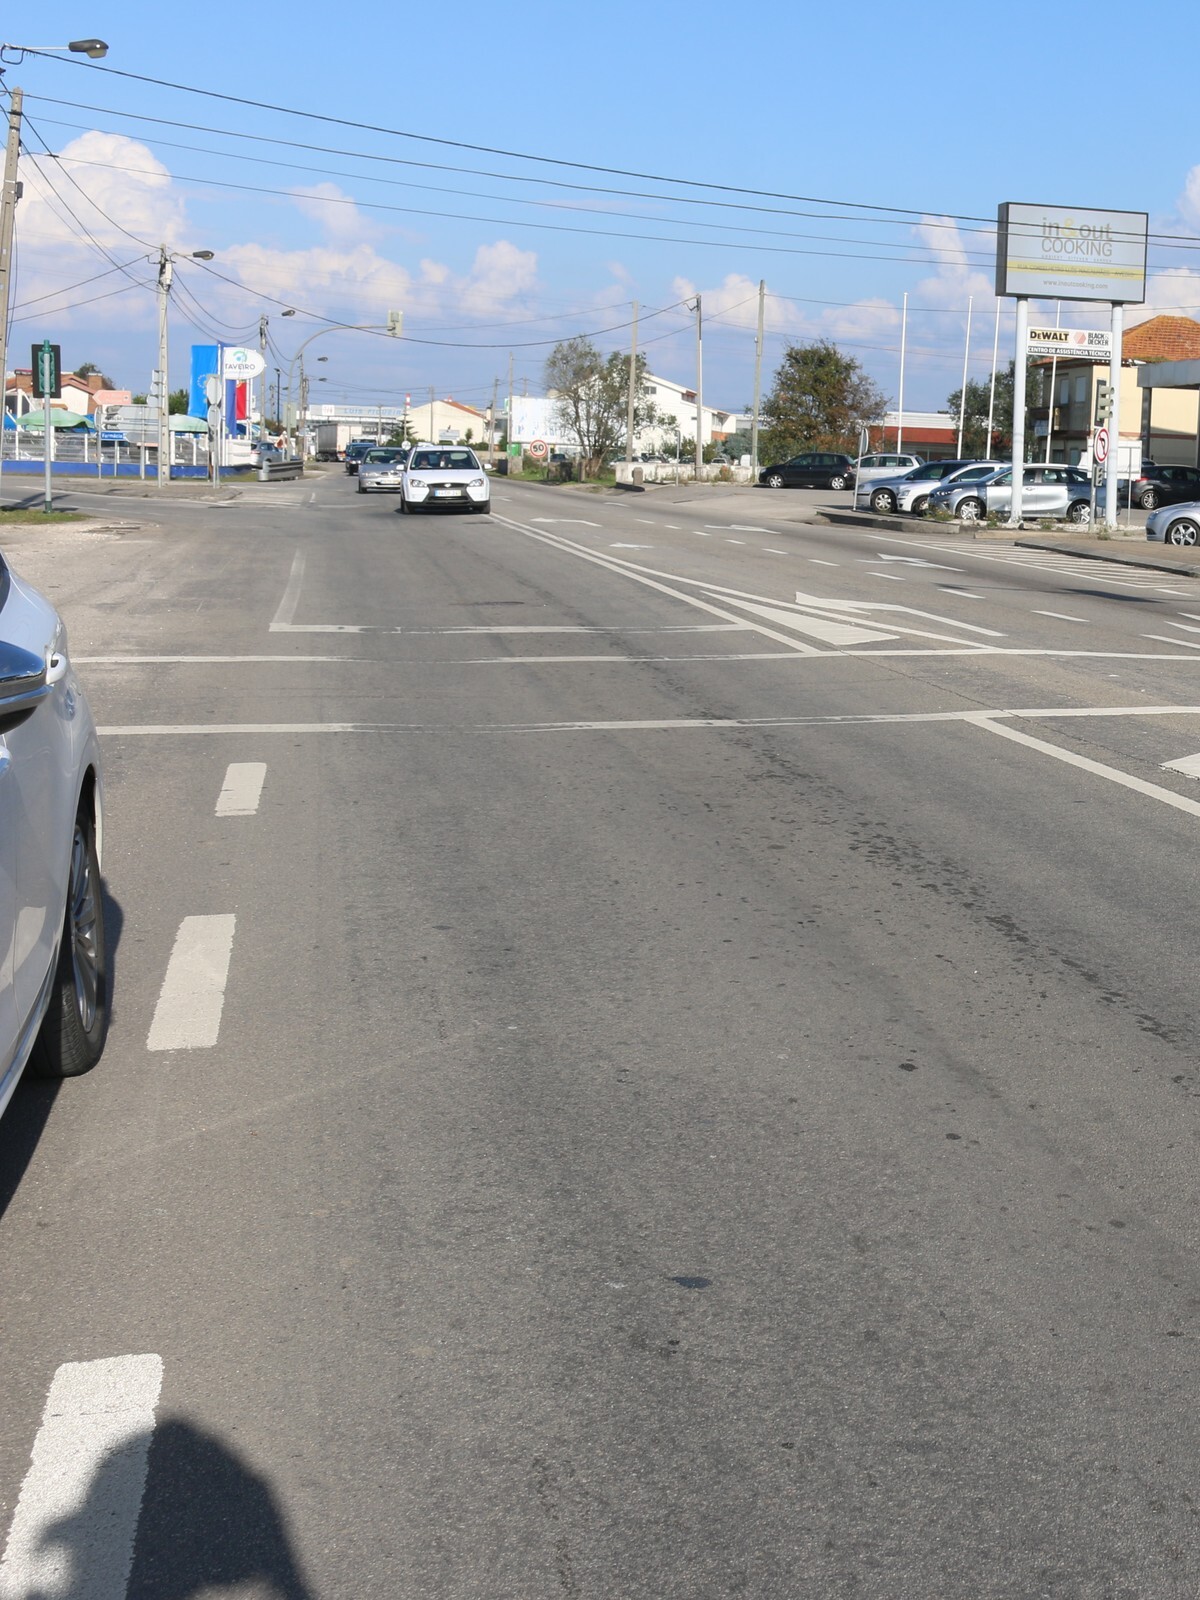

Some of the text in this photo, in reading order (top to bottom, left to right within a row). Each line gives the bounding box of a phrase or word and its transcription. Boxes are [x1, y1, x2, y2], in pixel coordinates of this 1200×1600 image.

[1041, 237, 1113, 257] COOKING
[1042, 279, 1109, 290] www.inoutcooking.com
[1028, 346, 1048, 354] CENTRO
[1056, 347, 1088, 356] ASSISTÊNCIA
[224, 363, 256, 371] TAVEIRO
[532, 444, 545, 453] 50
